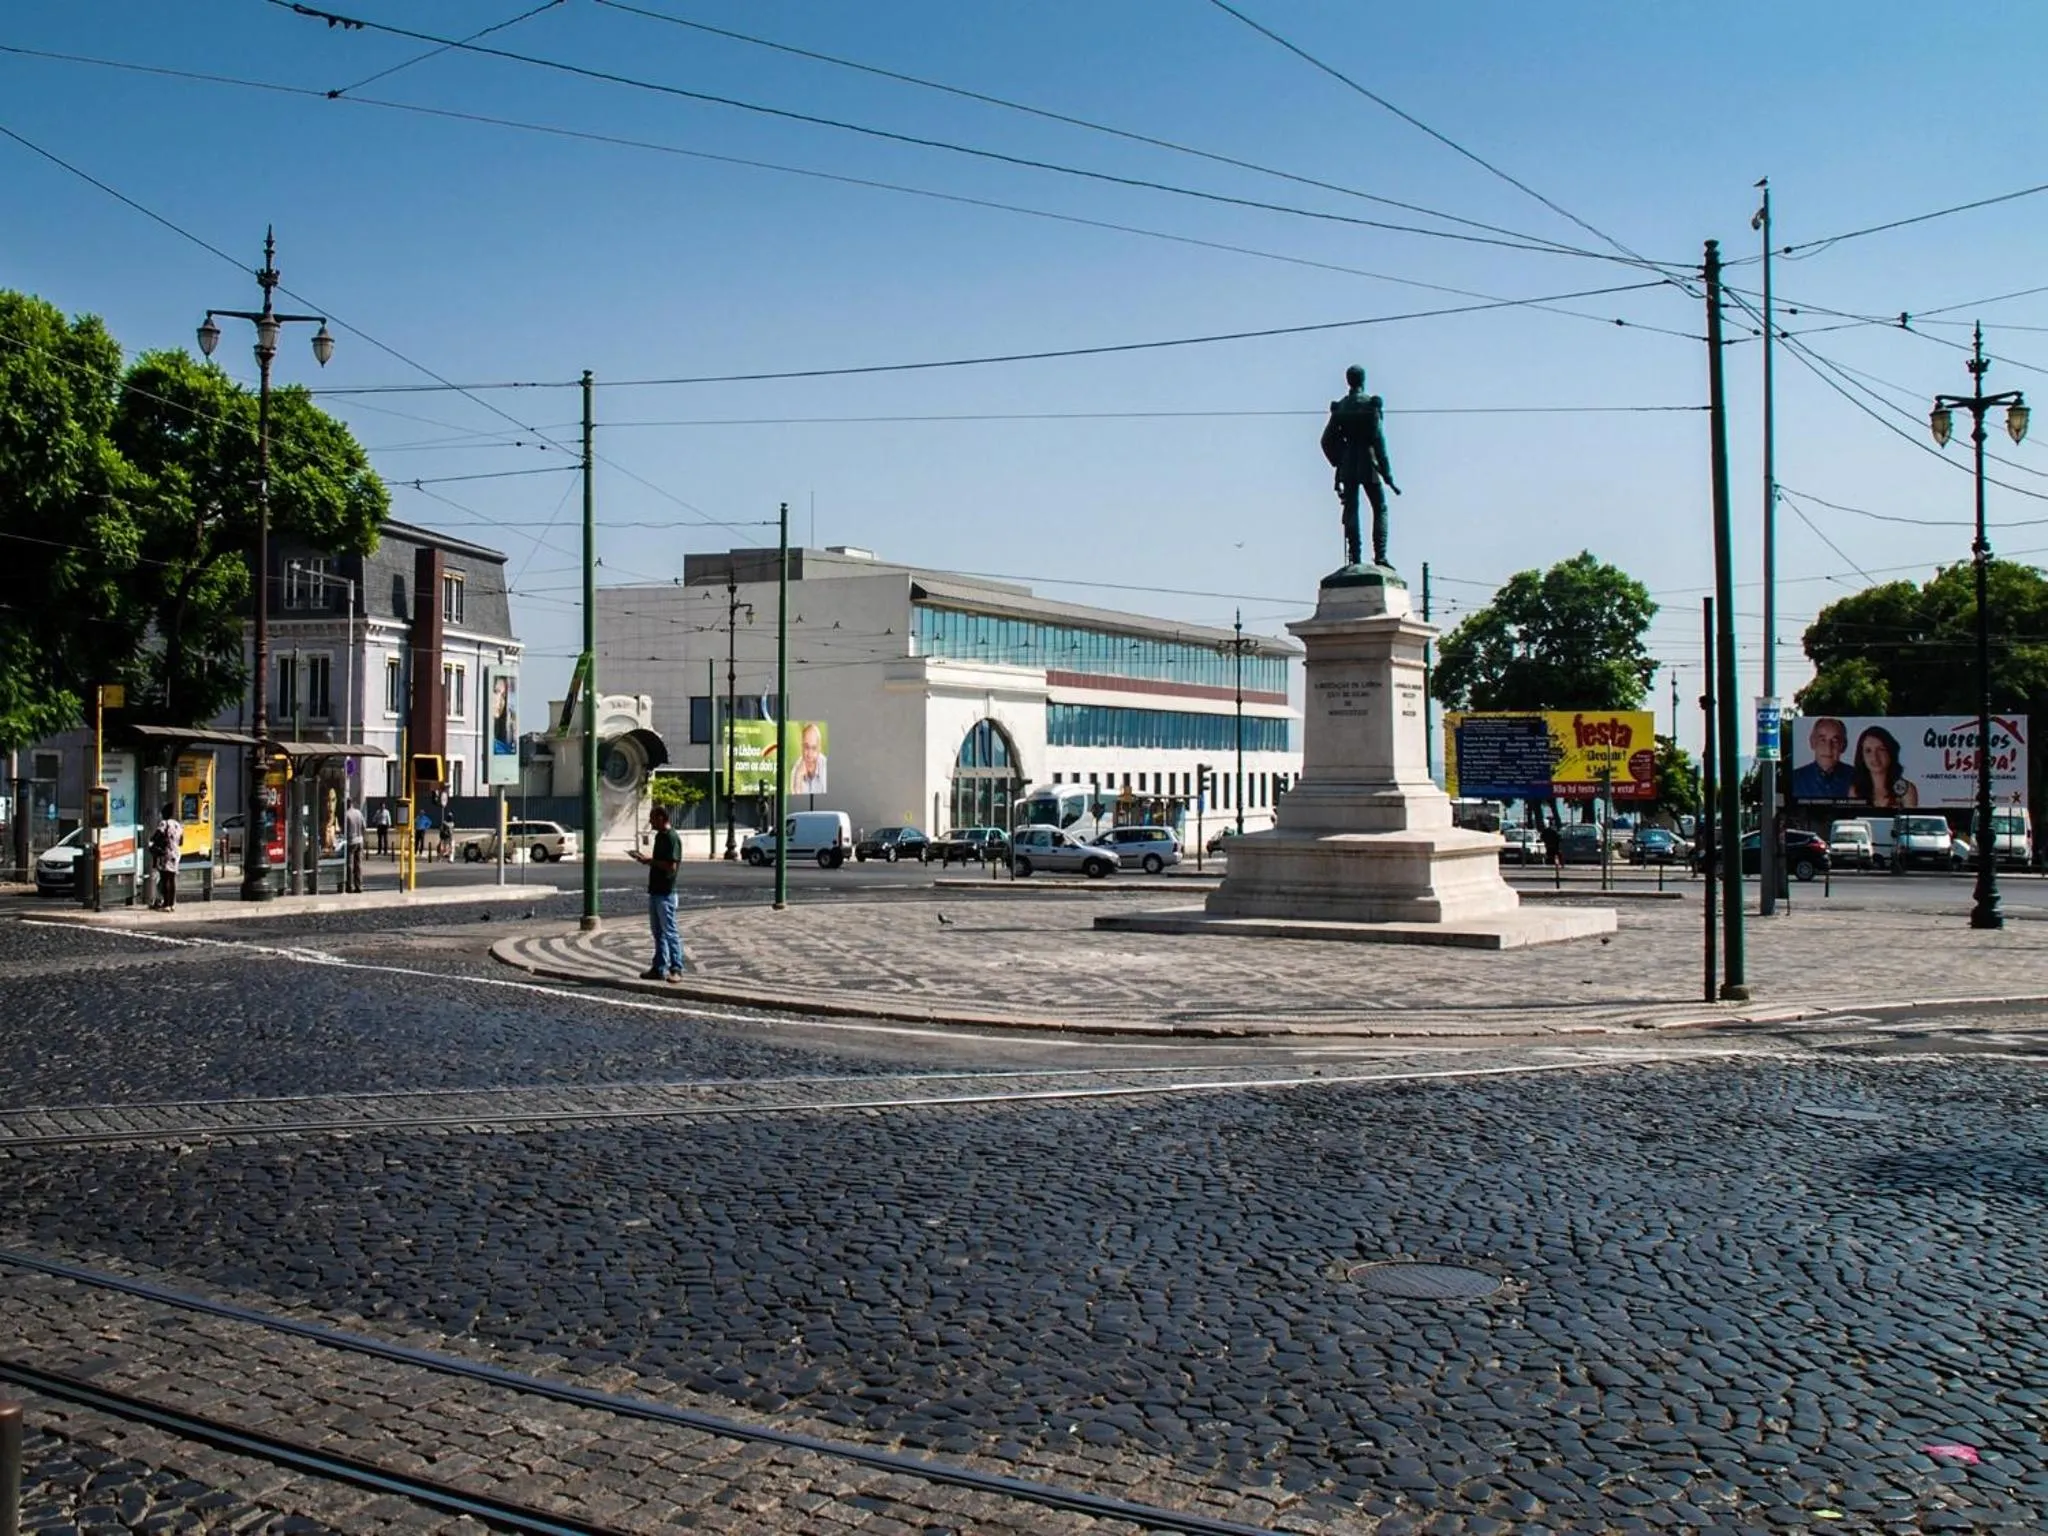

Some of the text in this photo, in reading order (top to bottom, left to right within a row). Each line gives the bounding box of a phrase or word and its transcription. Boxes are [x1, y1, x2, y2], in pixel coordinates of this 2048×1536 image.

[1573, 713, 1633, 749] festa
[1924, 728, 2010, 748] Quereos
[1553, 784, 1567, 794] Não
[1568, 783, 1577, 794] há
[1578, 784, 1596, 794] festa
[1617, 783, 1635, 794] esta!
